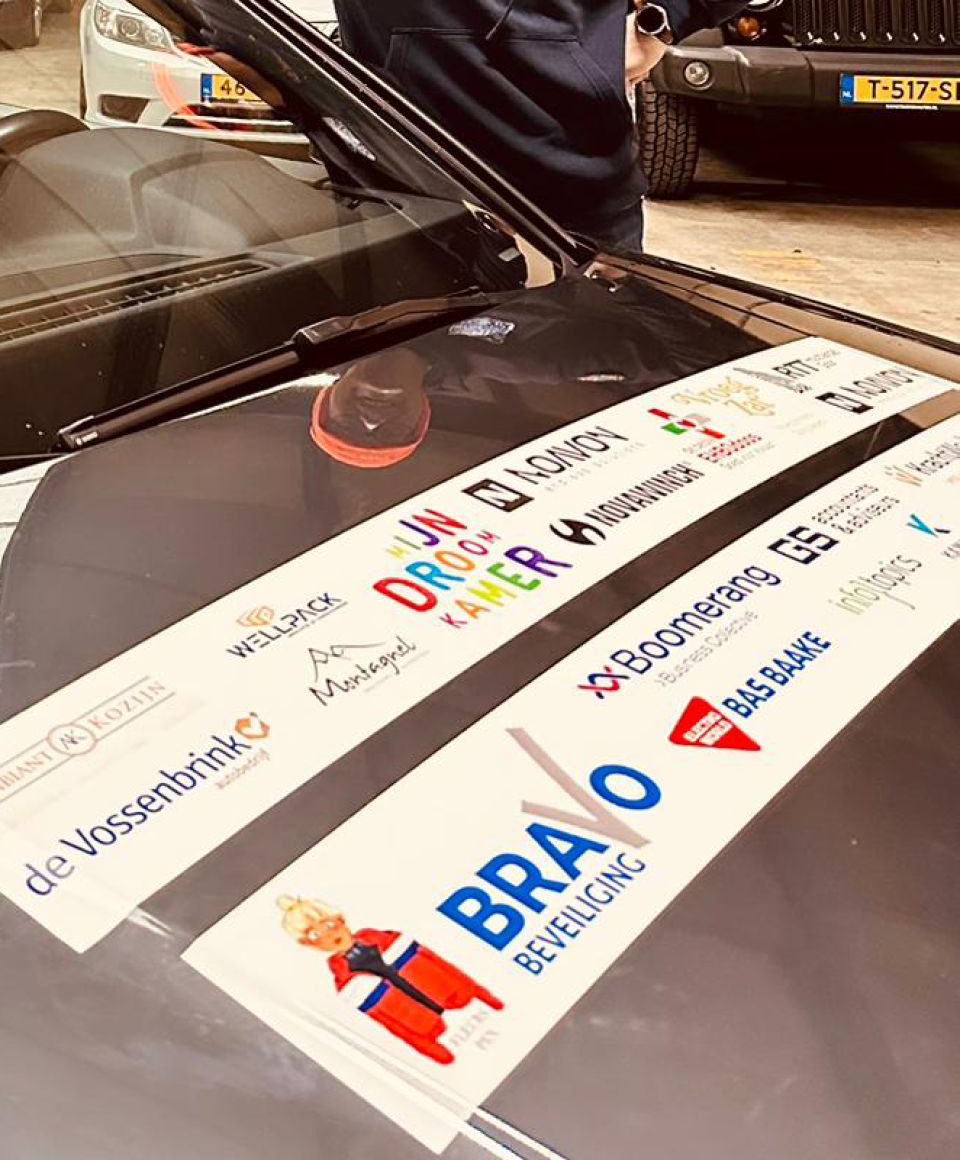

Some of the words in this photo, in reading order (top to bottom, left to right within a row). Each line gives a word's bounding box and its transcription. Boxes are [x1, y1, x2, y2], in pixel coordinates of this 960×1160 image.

[868, 79, 960, 100] T-517-S
[386, 508, 468, 559] MIJN
[584, 461, 705, 527] NOVAWINCH
[373, 529, 501, 612] DROOM
[439, 546, 573, 629] KAMER
[226, 592, 342, 658] WELLPACK
[610, 565, 782, 674] Boomerang
[88, 680, 166, 730] KOZIJN
[722, 677, 776, 718] BAS
[759, 631, 832, 688] BAAKE
[25, 854, 75, 897] de
[60, 734, 252, 858] Vossenbrink
[435, 727, 662, 951] BRAVO
[512, 852, 646, 976] BEVEILIGING
